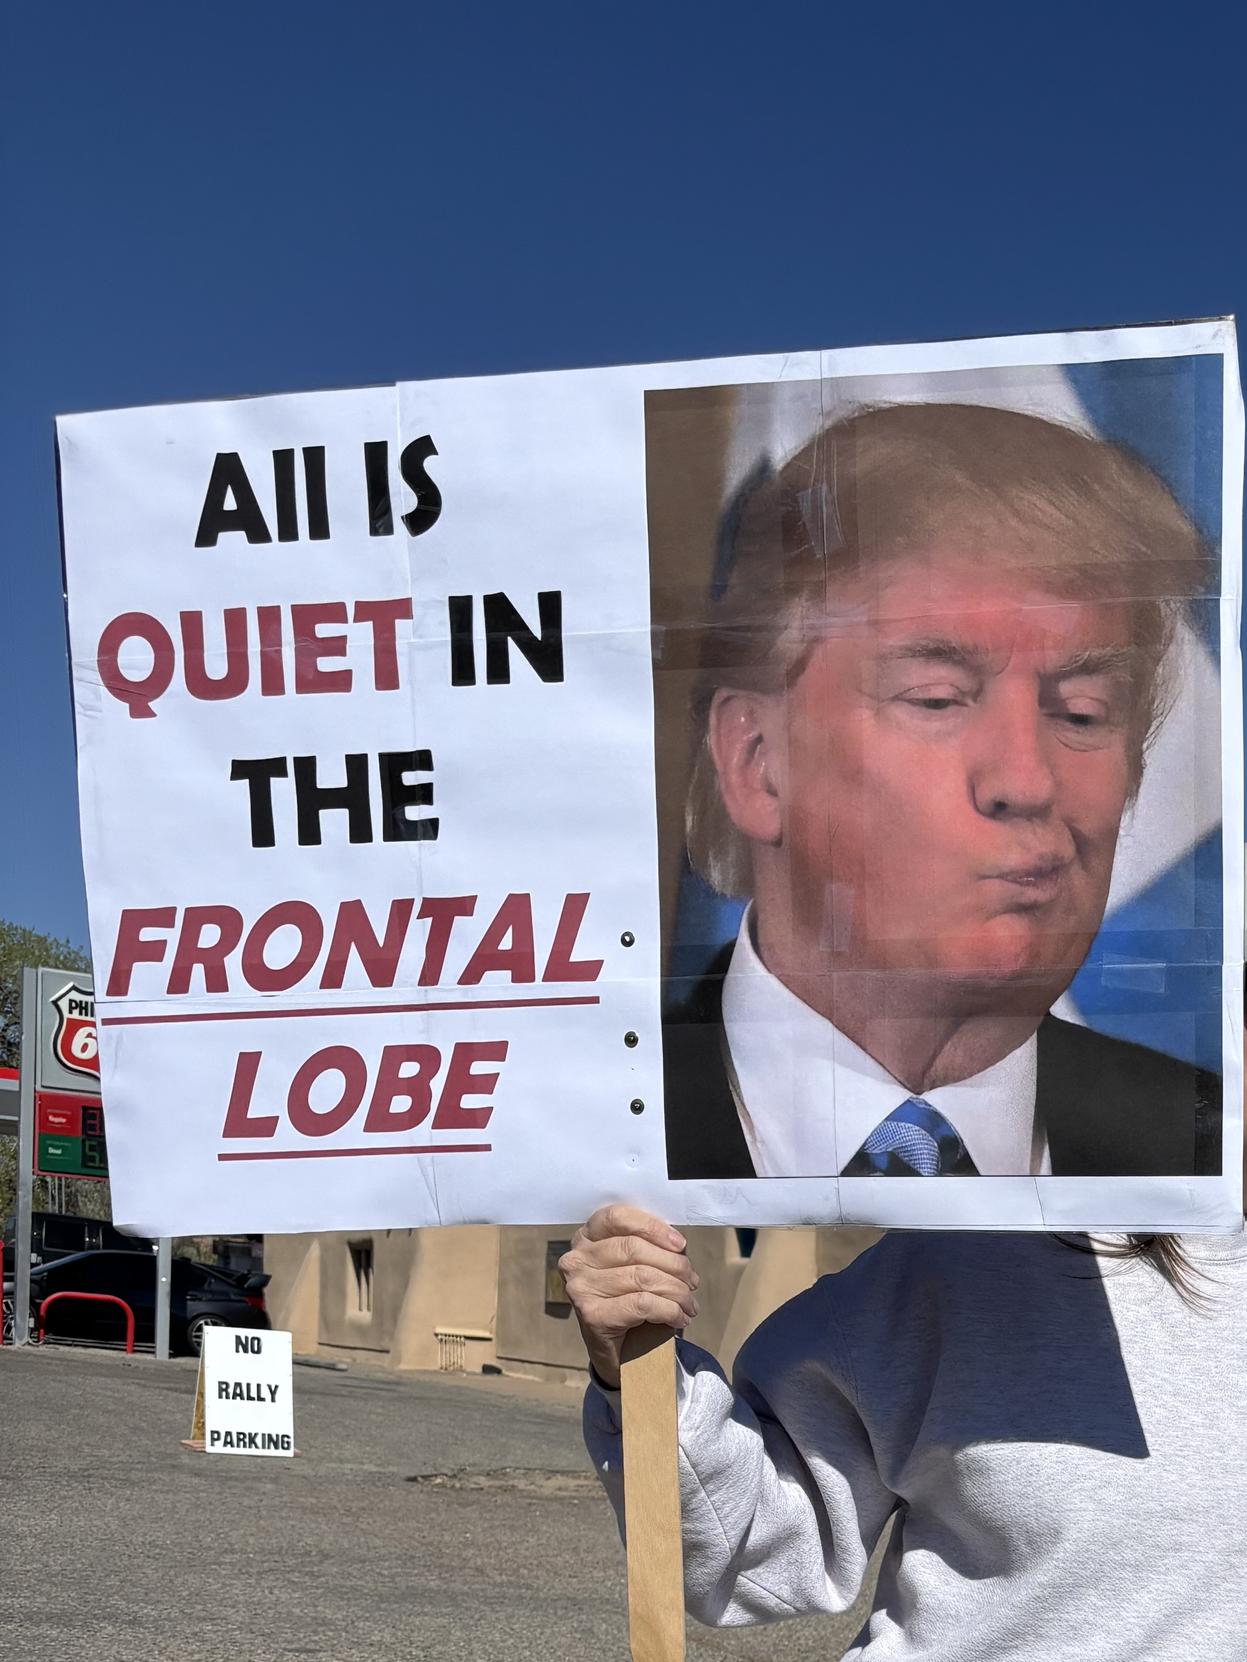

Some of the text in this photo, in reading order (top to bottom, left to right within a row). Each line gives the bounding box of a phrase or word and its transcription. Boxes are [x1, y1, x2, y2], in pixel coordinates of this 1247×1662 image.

[195, 435, 442, 547] All IS
[97, 591, 564, 718] QUIET IN
[230, 749, 439, 848] THE
[106, 893, 603, 996] FRONTAL
[223, 1041, 508, 1138] LOBE
[217, 1380, 280, 1403] RALLY
[235, 1334, 262, 1354] NO
[210, 1429, 292, 1451] PARKING
